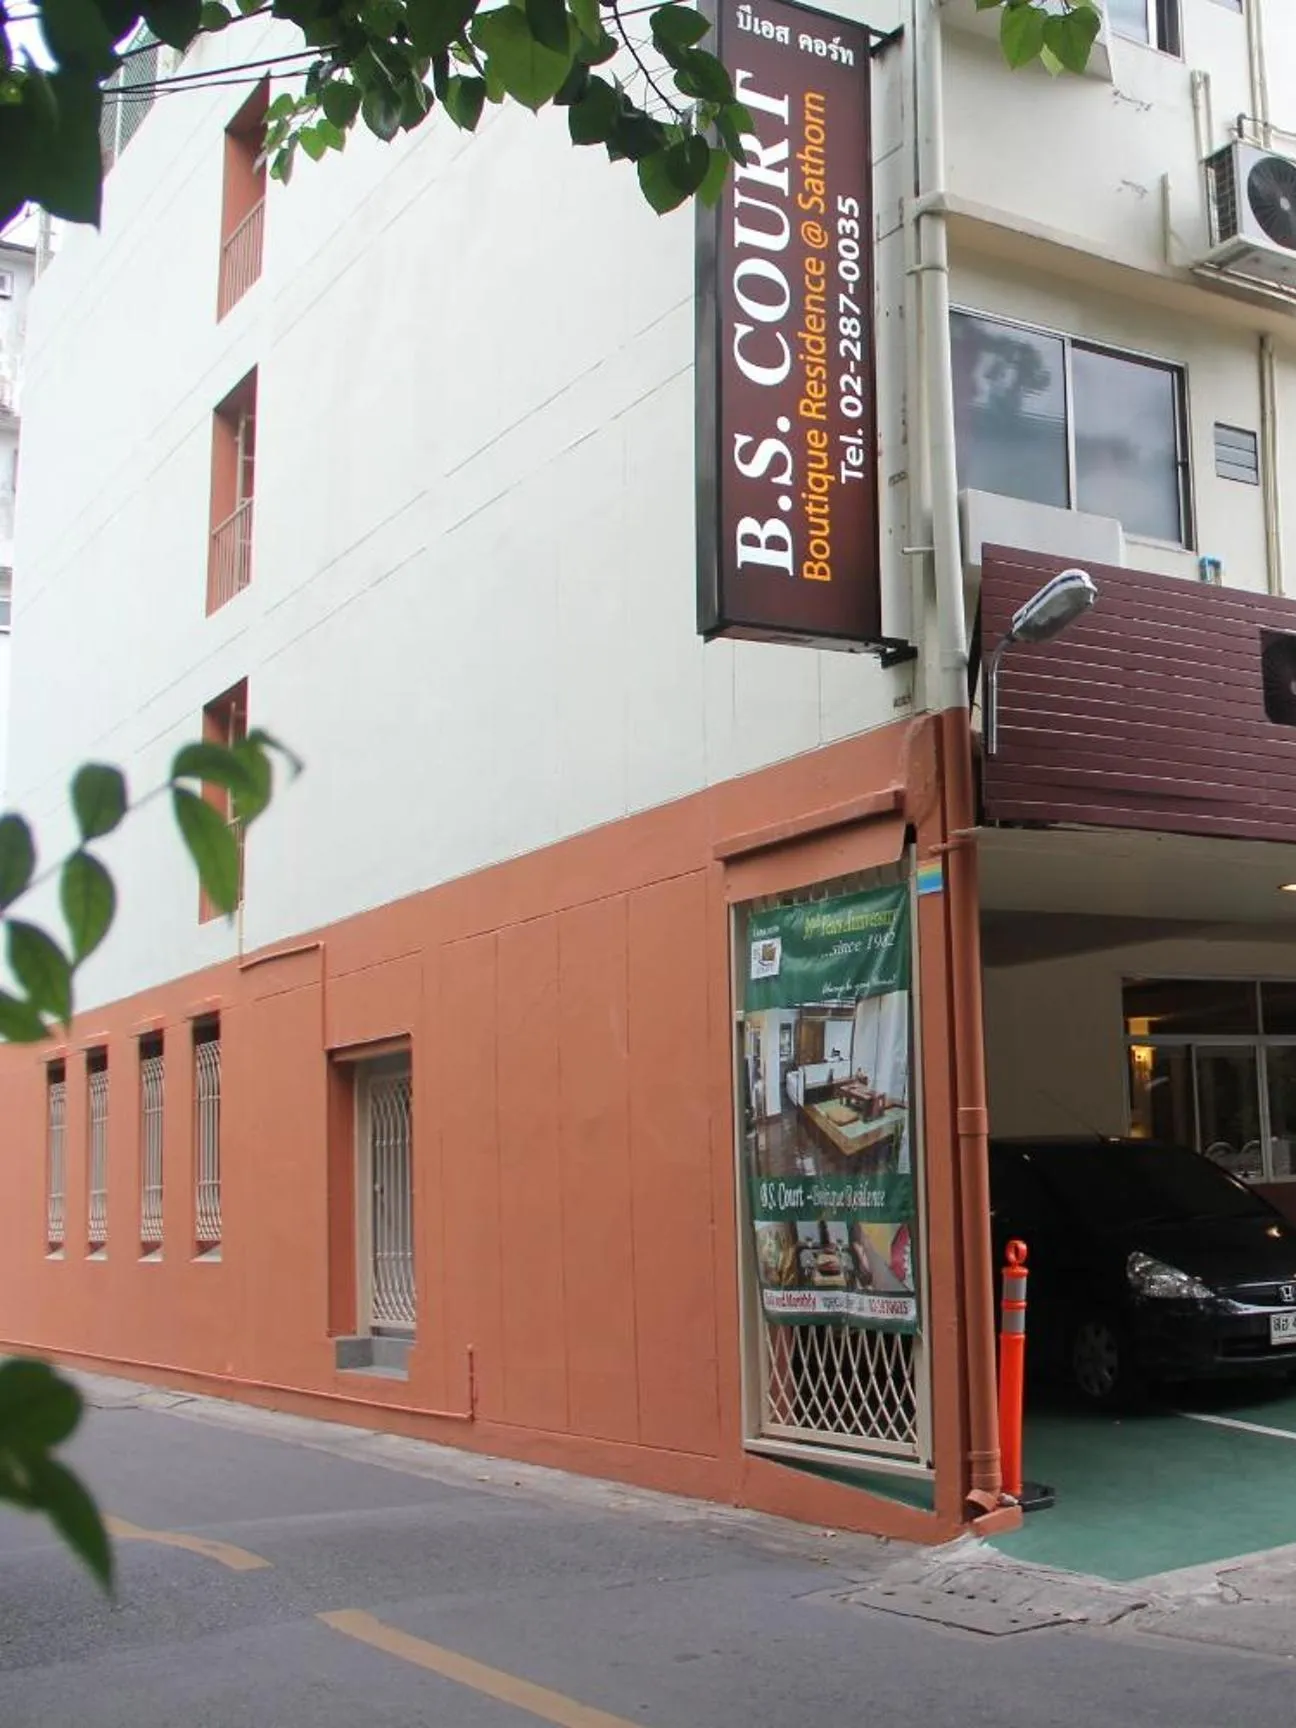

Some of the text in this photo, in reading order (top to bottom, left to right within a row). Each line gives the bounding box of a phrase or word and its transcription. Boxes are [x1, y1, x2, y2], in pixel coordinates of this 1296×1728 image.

[735, 4, 854, 66] บีเอส คอร์ท
[733, 69, 793, 576] B.S. COURT
[797, 91, 835, 581] Boutique Residence @ Sathorn
[837, 195, 864, 484] Tel. 02-287-0035
